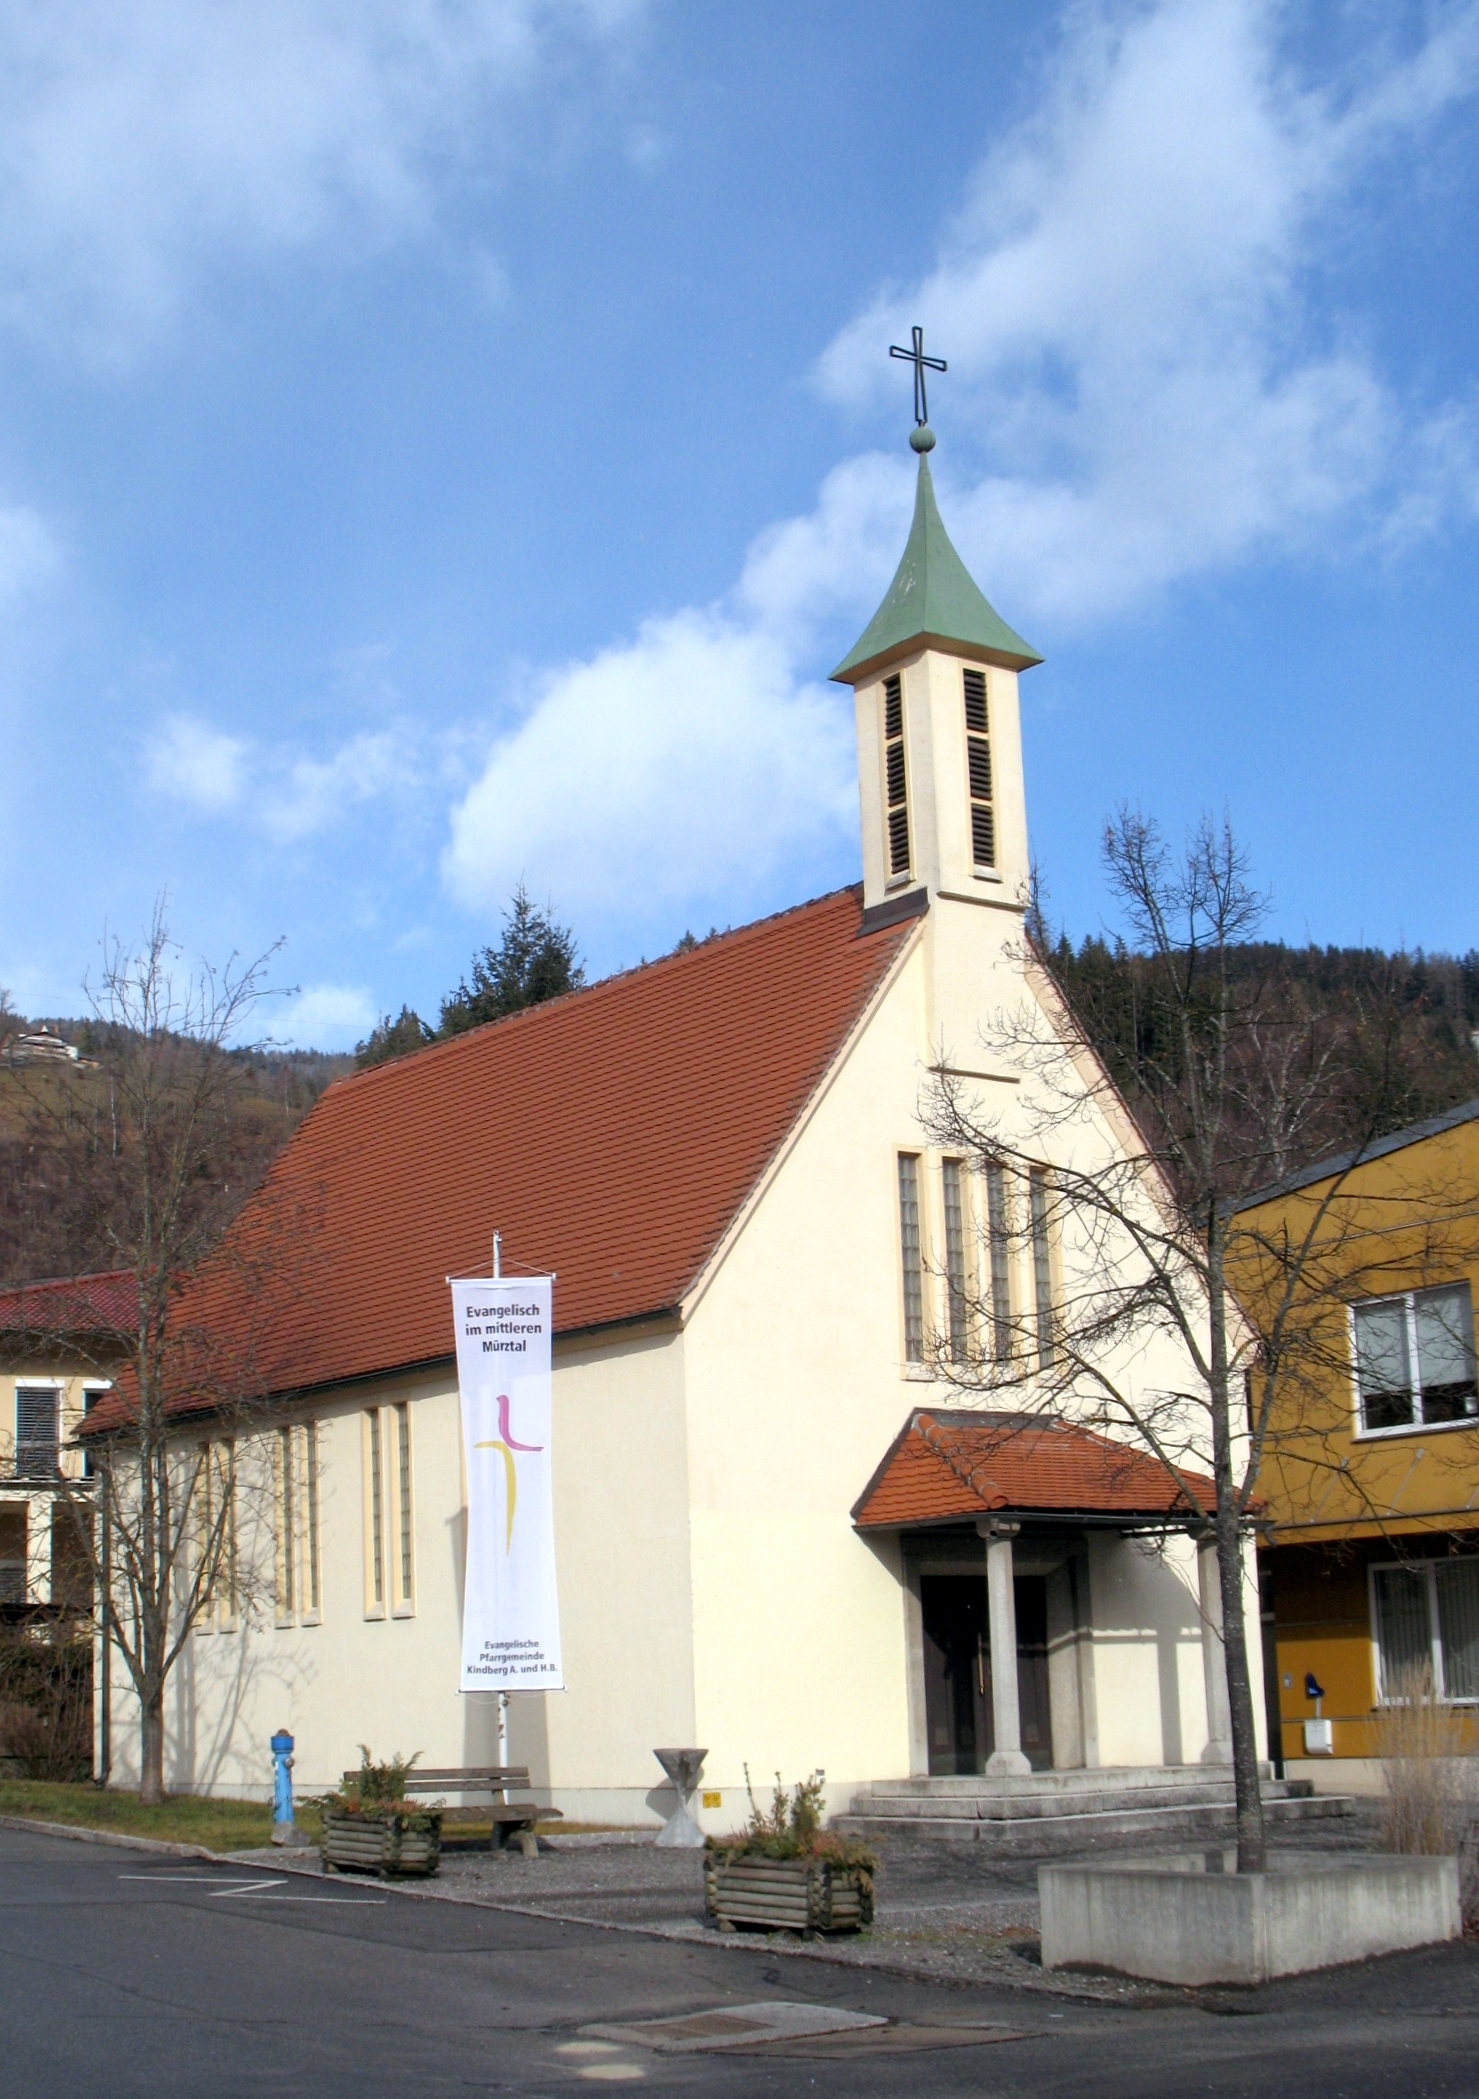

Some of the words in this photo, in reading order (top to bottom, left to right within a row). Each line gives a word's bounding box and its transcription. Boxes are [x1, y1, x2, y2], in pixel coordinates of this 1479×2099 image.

[466, 1304, 540, 1319] Evangelisch
[465, 1323, 482, 1336] im
[485, 1322, 542, 1335] mittleren
[482, 1340, 527, 1352] Mürztal
[485, 1640, 540, 1650] Evangelische
[480, 1652, 545, 1663] Pfarrgemeinde
[467, 1665, 508, 1676] Kindberg
[510, 1665, 518, 1674] A.
[521, 1664, 538, 1673] und
[541, 1664, 558, 1672] H.B.
